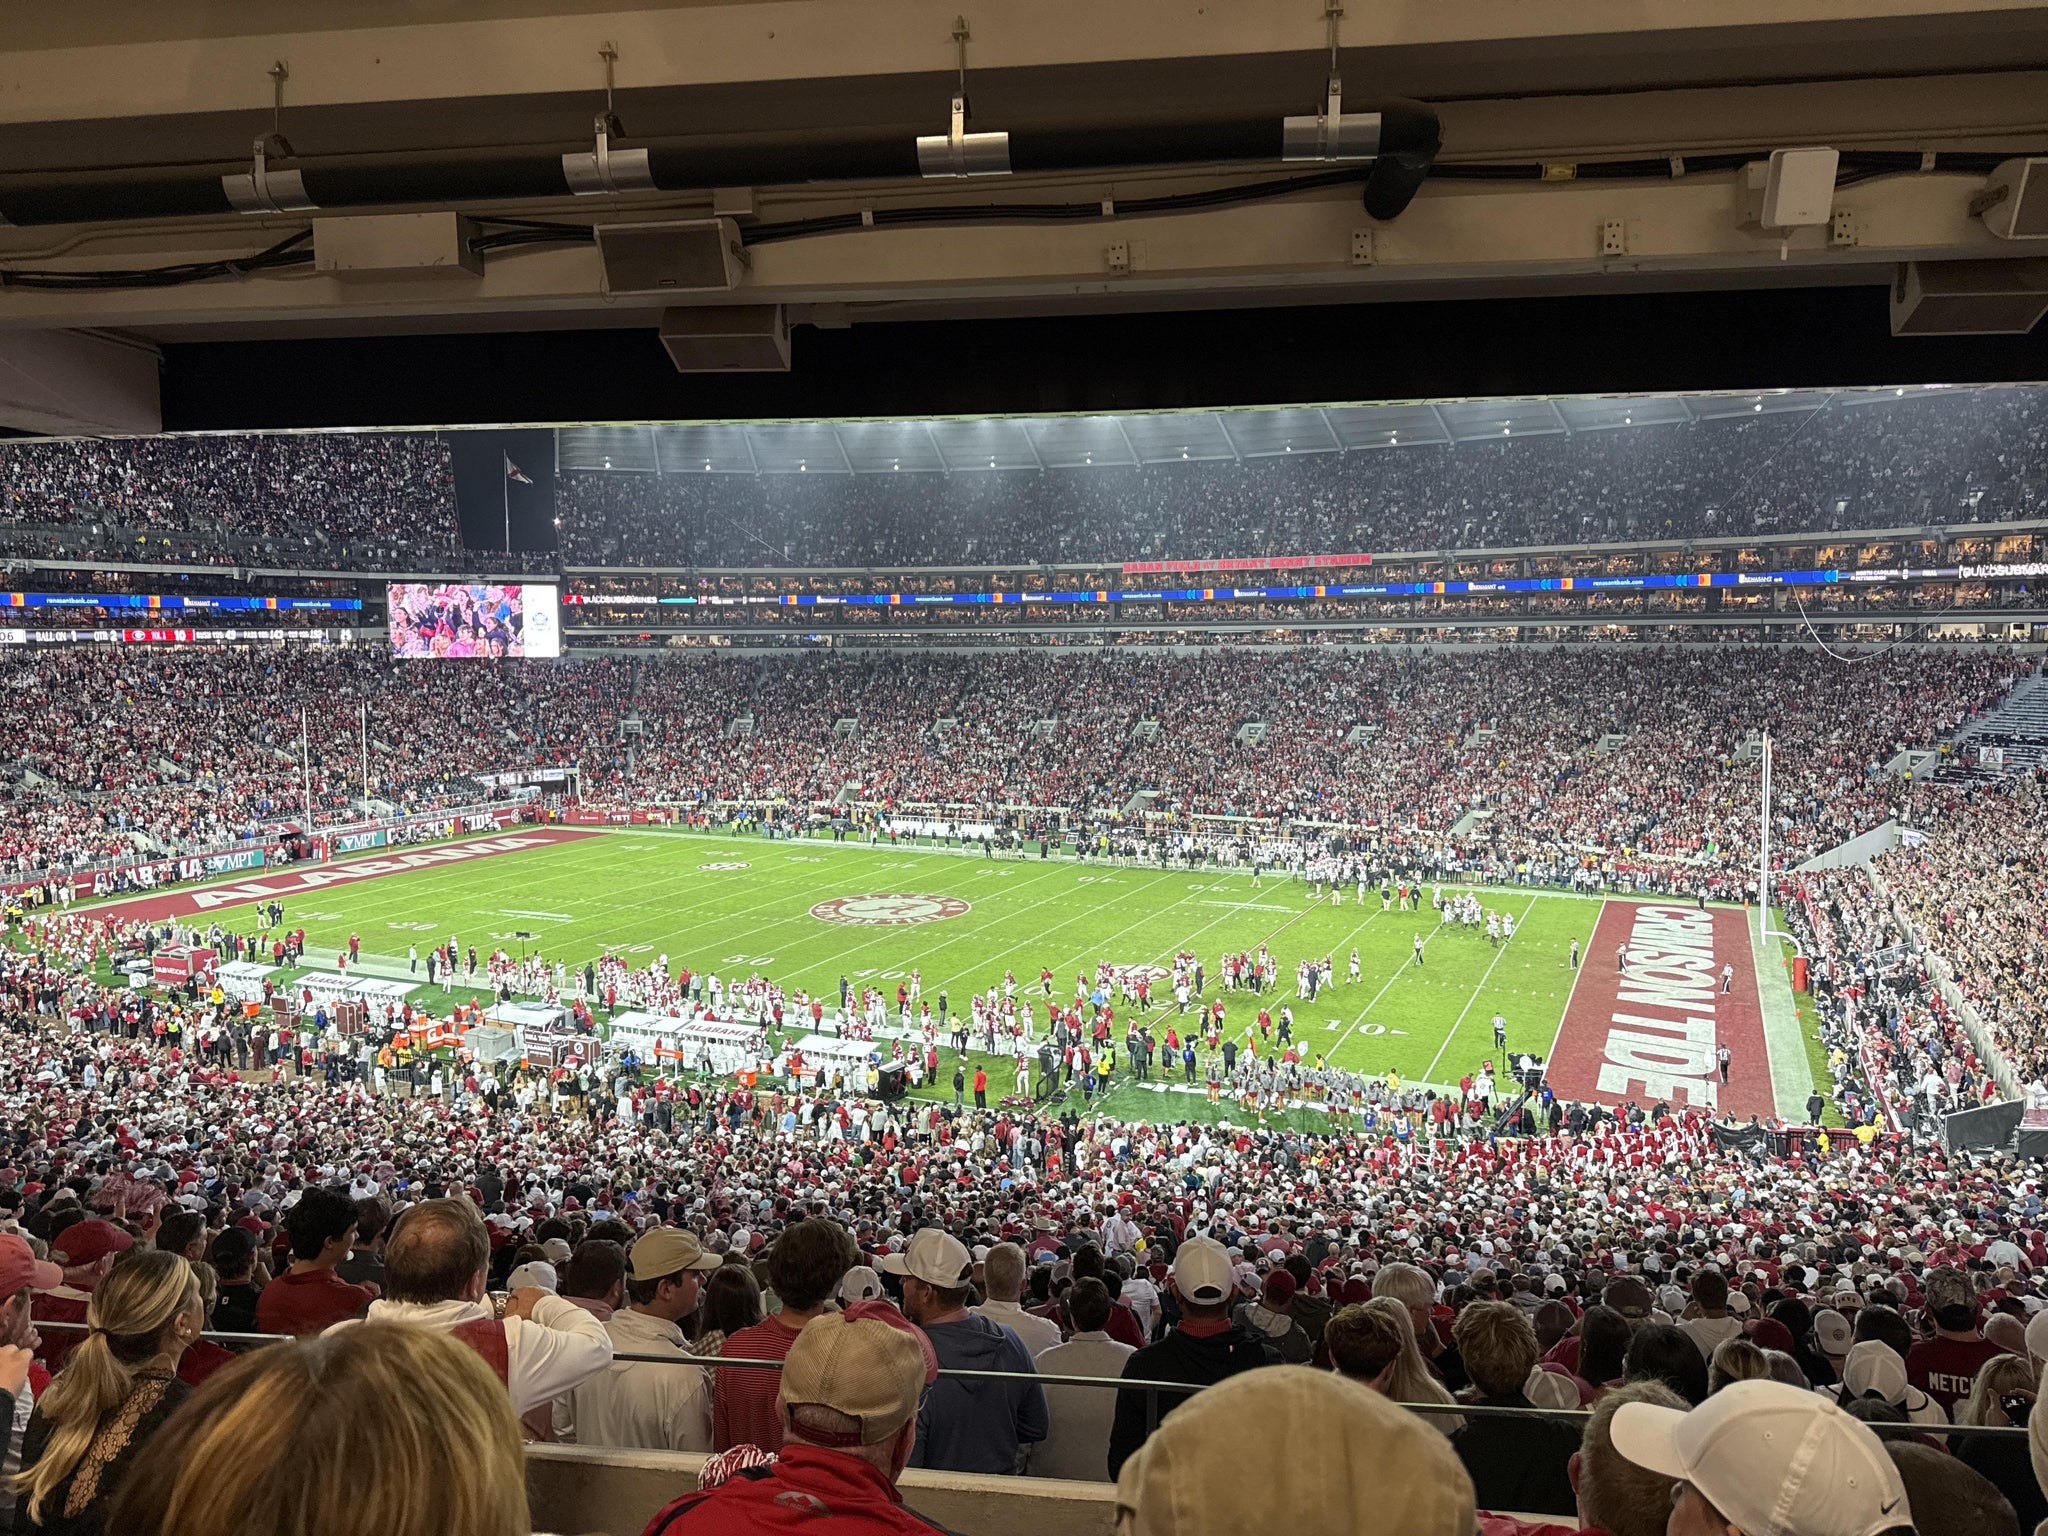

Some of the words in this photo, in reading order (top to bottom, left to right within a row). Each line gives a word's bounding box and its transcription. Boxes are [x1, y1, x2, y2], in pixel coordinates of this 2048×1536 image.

[1165, 560, 1200, 571] FIELD
[1314, 553, 1372, 566] STADIUM
[35, 630, 55, 642] BALL
[56, 631, 67, 641] ON
[110, 629, 118, 641] 2
[174, 629, 186, 641] 10
[611, 814, 631, 822] YETI
[353, 831, 378, 849] MPT
[227, 851, 255, 870] MPT
[191, 836, 557, 908] ALABAMA
[721, 954, 776, 965] 50
[1616, 906, 1716, 1013] CRIMSON
[852, 968, 906, 980] 40
[685, 1024, 749, 1038] ALABAMA
[1318, 1019, 1386, 1035] 10
[1595, 1013, 1718, 1109] TIDE
[740, 1075, 748, 1083] G
